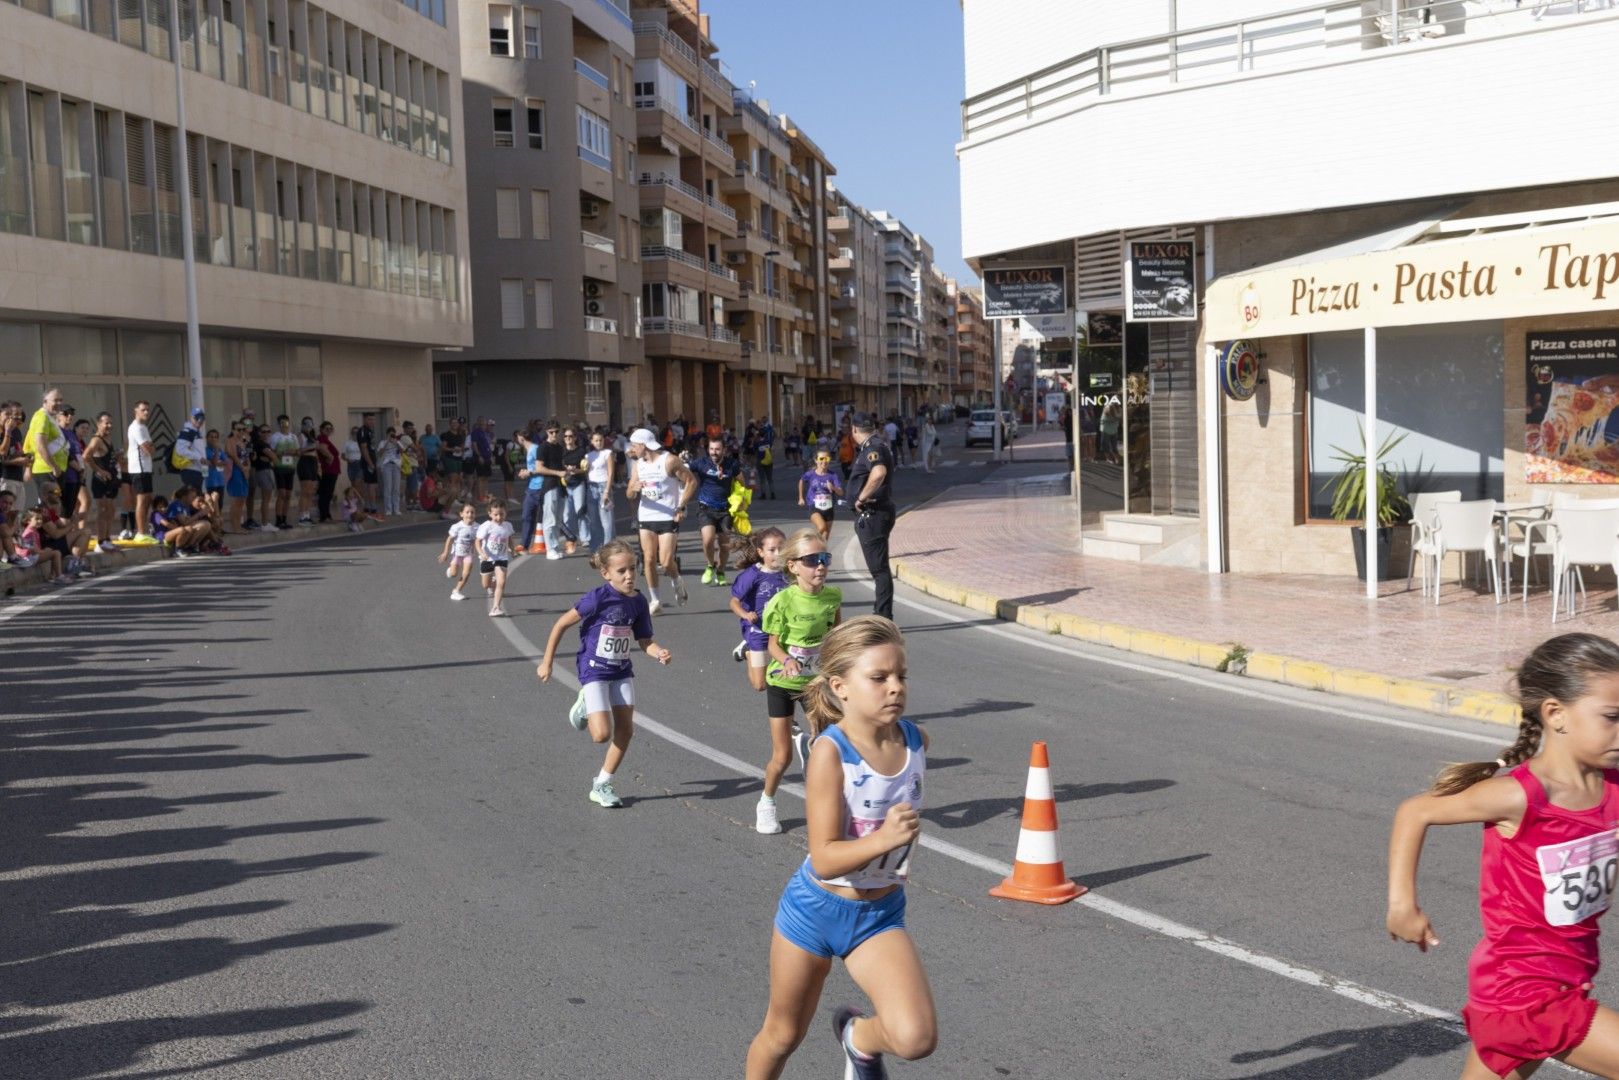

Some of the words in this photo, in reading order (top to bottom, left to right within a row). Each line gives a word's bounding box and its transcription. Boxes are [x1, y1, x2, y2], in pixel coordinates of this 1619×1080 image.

[1134, 245, 1190, 258] LUXOR
[995, 269, 1052, 284] LUXOR
[1290, 275, 1360, 316] Pizza
[1392, 260, 1497, 305] Pasta
[1537, 243, 1619, 300] Tap
[1531, 339, 1566, 351] Pizza
[1569, 338, 1617, 350] casera
[603, 637, 630, 654] 500
[1561, 857, 1618, 911] 530
